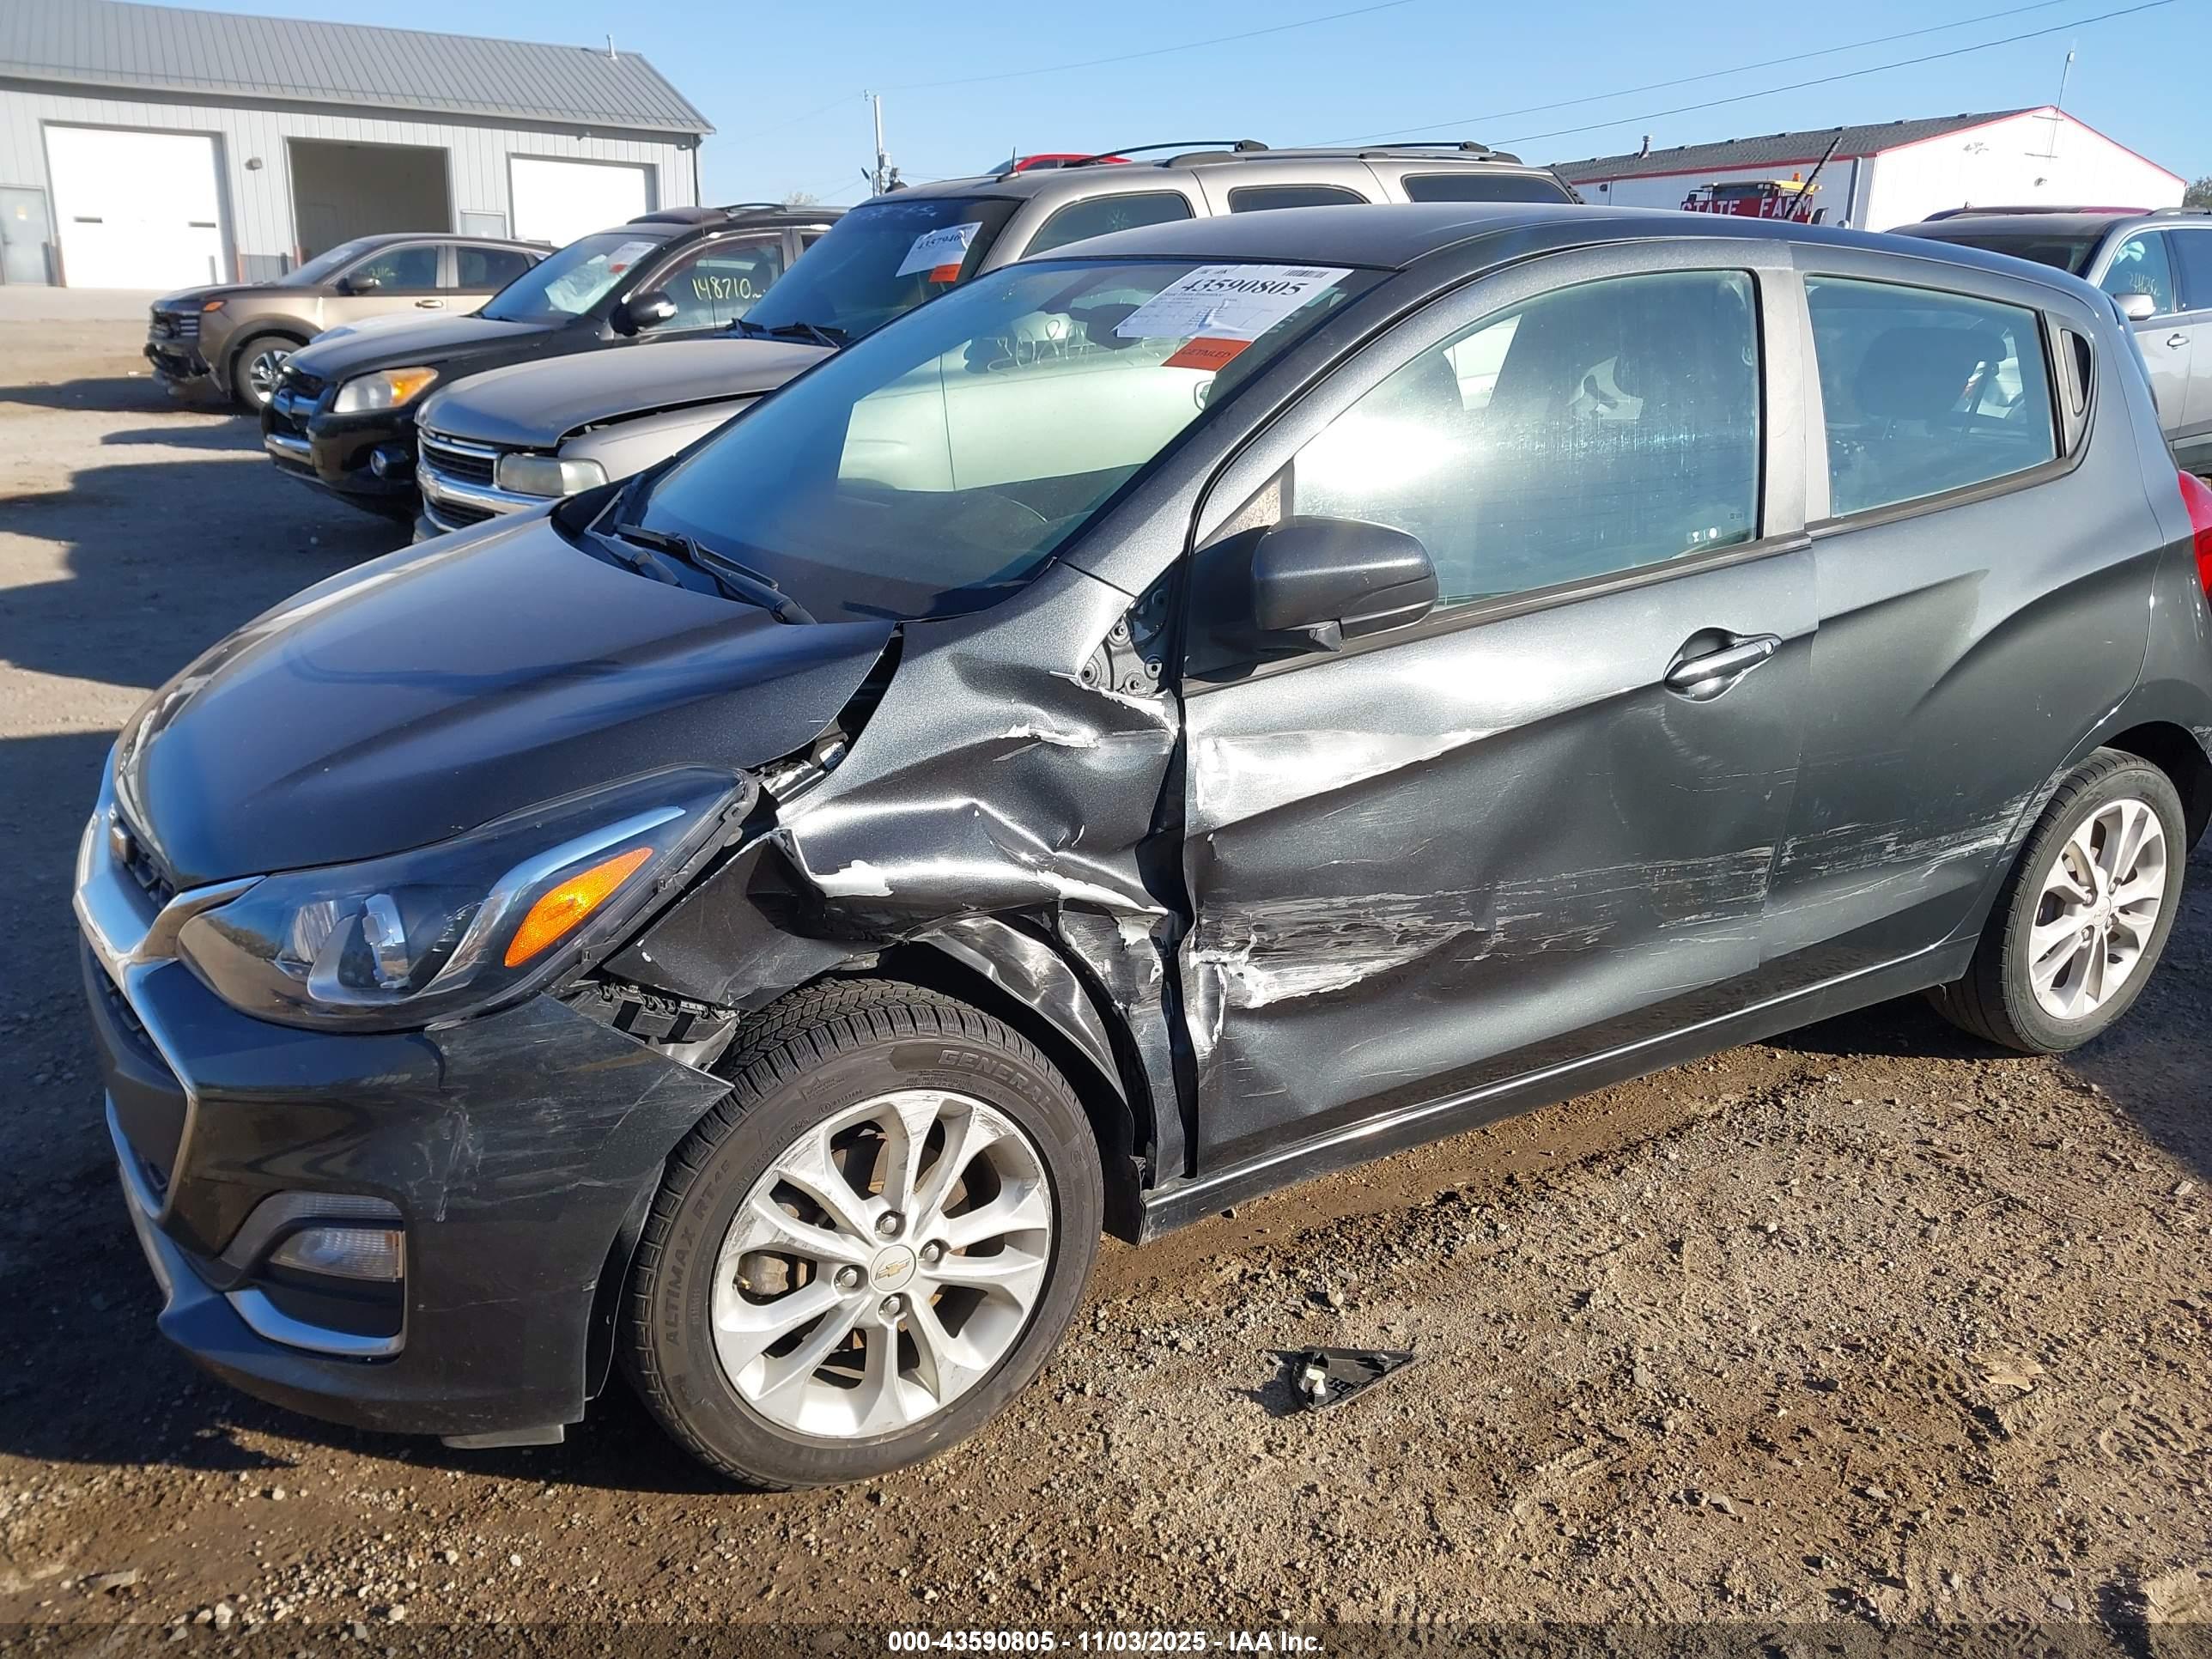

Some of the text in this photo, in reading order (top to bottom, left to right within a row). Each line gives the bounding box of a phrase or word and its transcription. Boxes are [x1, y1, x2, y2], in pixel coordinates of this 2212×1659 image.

[692, 276, 751, 301] 148710
[1181, 278, 1310, 295] 43590805
[938, 1049, 1051, 1115] GENERAL
[665, 1228, 696, 1346] ALTIMAX
